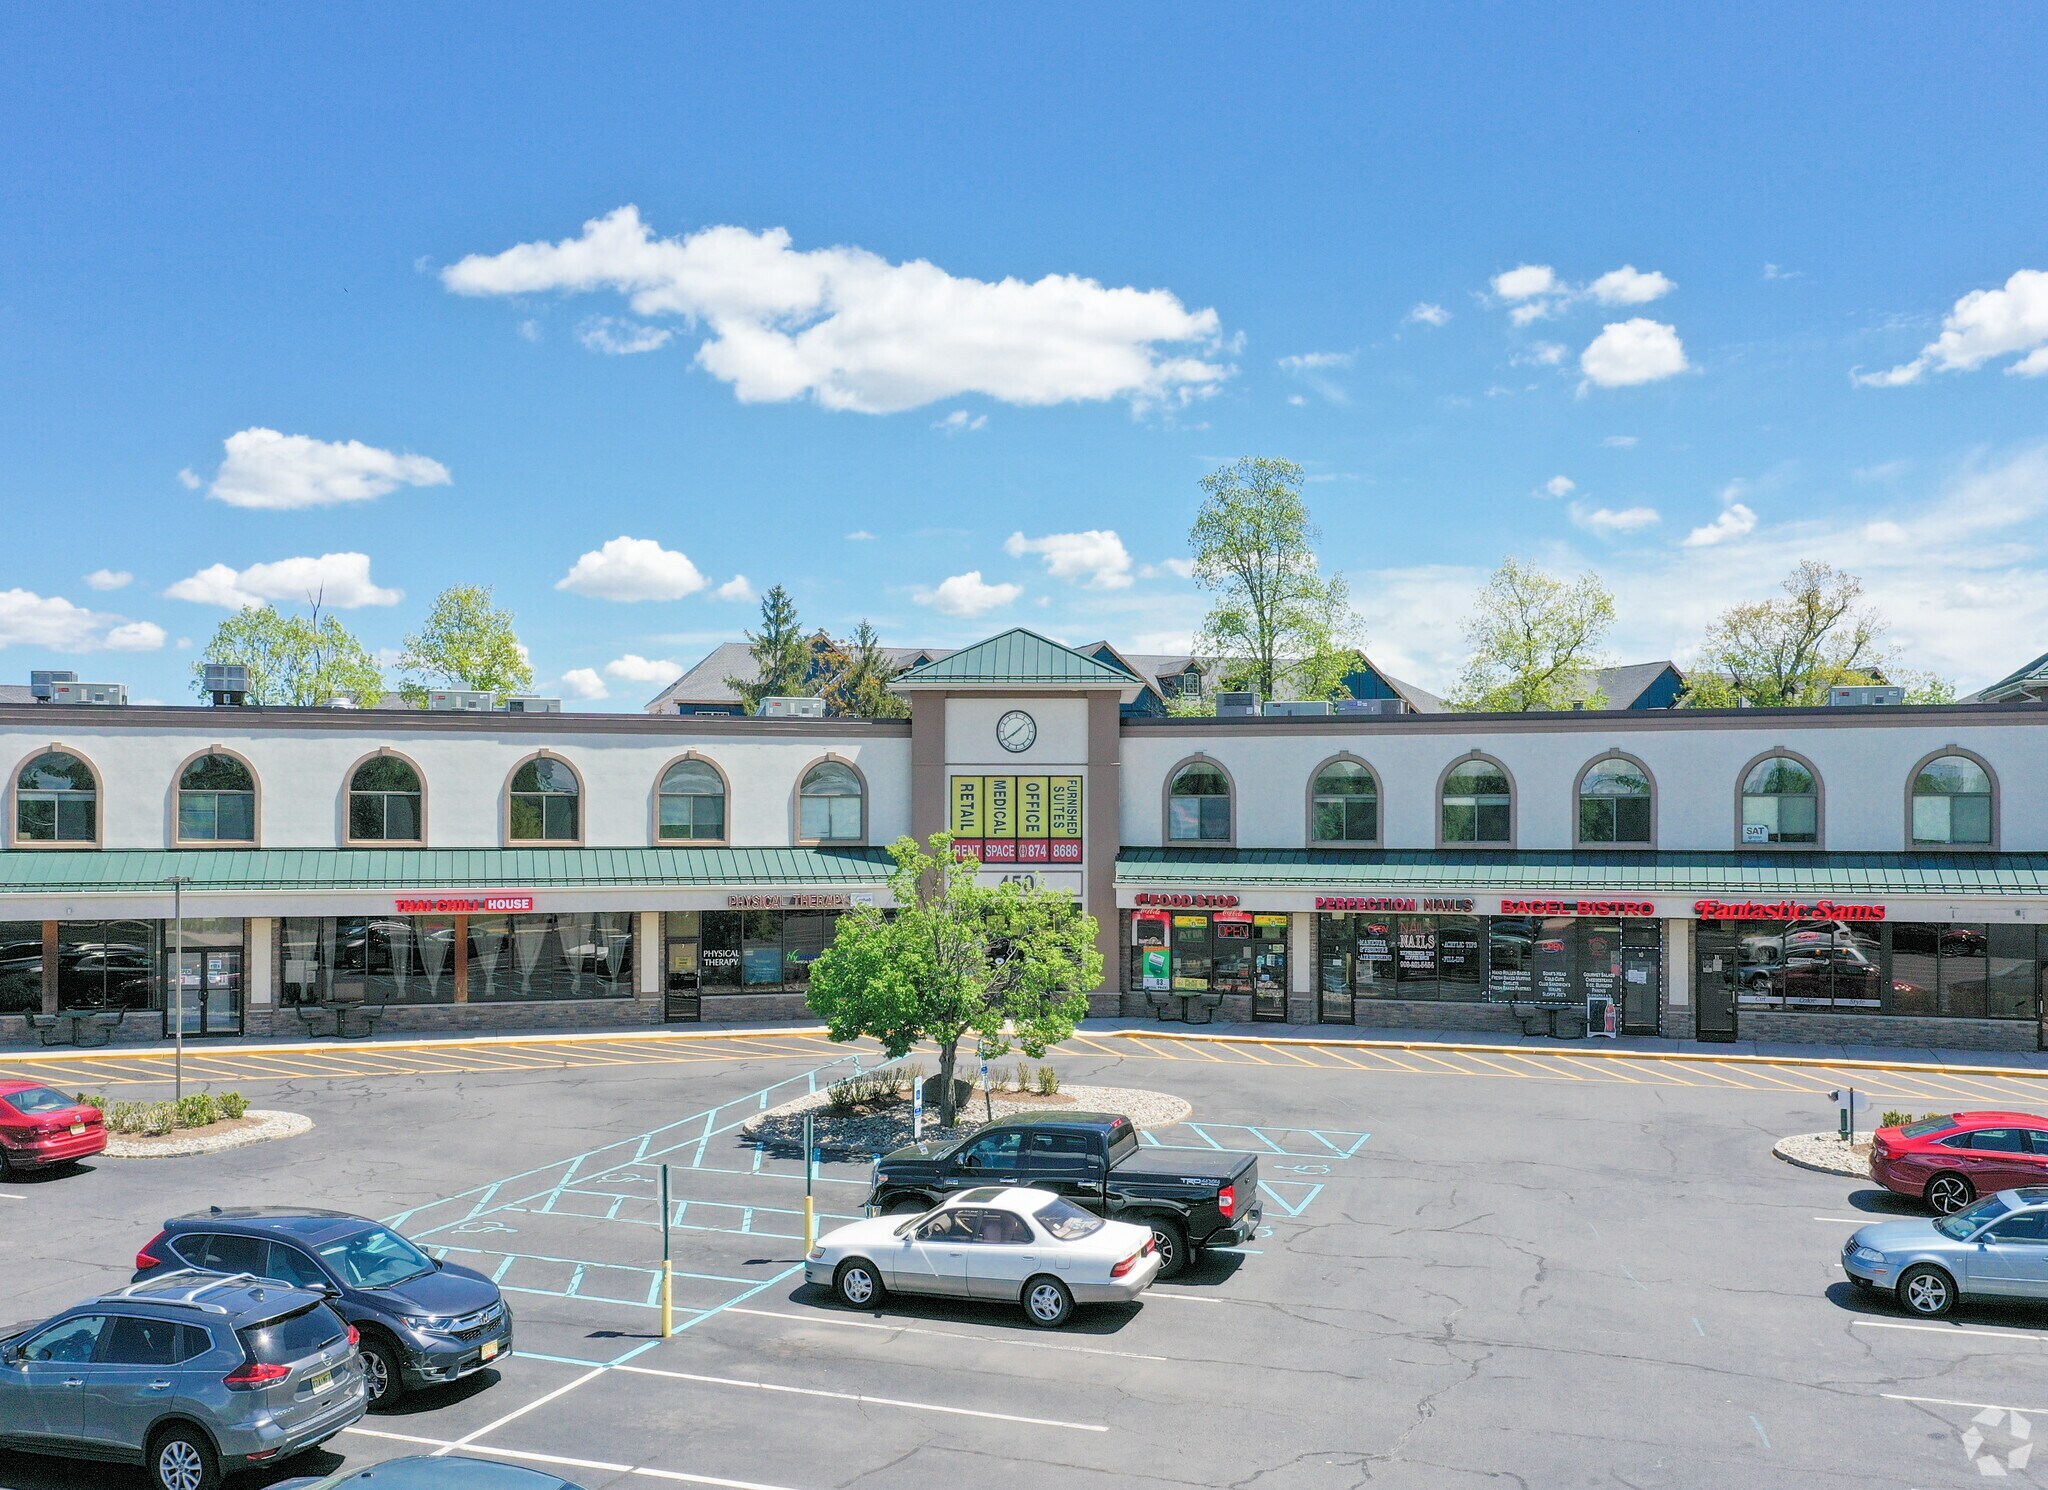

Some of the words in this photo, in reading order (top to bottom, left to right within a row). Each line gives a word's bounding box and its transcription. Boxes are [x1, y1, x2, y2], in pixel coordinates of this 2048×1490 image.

[961, 784, 974, 830] RETAIL
[994, 780, 1006, 834] MEDICAL
[1026, 783, 1040, 832] OFFICE
[1054, 786, 1064, 828] SUITES
[1067, 780, 1077, 835] FURNISHED
[1746, 826, 1765, 835] SAT
[955, 844, 980, 857] RENT
[985, 844, 1015, 857] SPACE
[1053, 844, 1078, 858] 8686
[395, 900, 433, 912] THAI
[436, 900, 478, 912] CHILI
[488, 899, 530, 910] HOUSE
[728, 894, 787, 909] PHYSICAL
[792, 893, 850, 909] THERAPY
[1195, 894, 1240, 908] STOP
[1315, 896, 1418, 911] PERFECTION
[1423, 898, 1475, 912] NAILS
[1501, 899, 1570, 915] BAGEL
[1577, 901, 1655, 916] BISTRO
[1694, 899, 1808, 921] Fantastic
[1811, 899, 1886, 921] Sams
[1219, 925, 1249, 937] OPEN
[1400, 935, 1435, 949] NAILS
[703, 949, 740, 957] PHYSICAL
[704, 958, 738, 966] THERAPY
